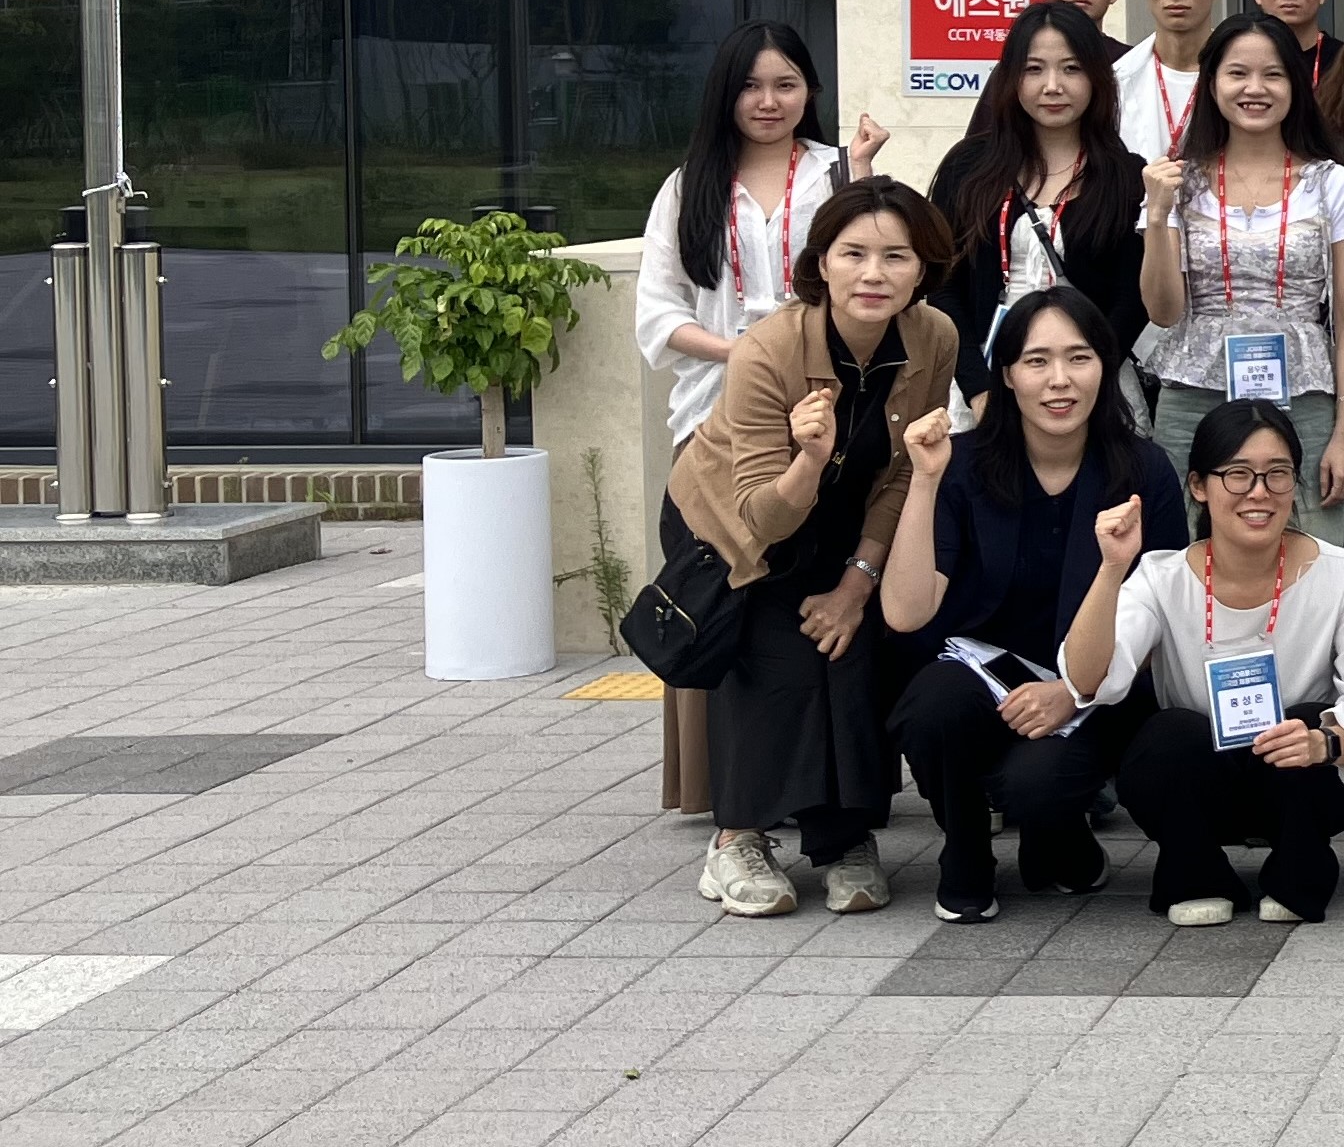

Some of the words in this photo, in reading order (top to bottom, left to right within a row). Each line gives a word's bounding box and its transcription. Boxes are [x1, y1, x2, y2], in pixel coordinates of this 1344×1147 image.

[948, 28, 982, 42] CCTV
[983, 27, 1010, 42] 작동
[910, 73, 979, 90] SECOM
